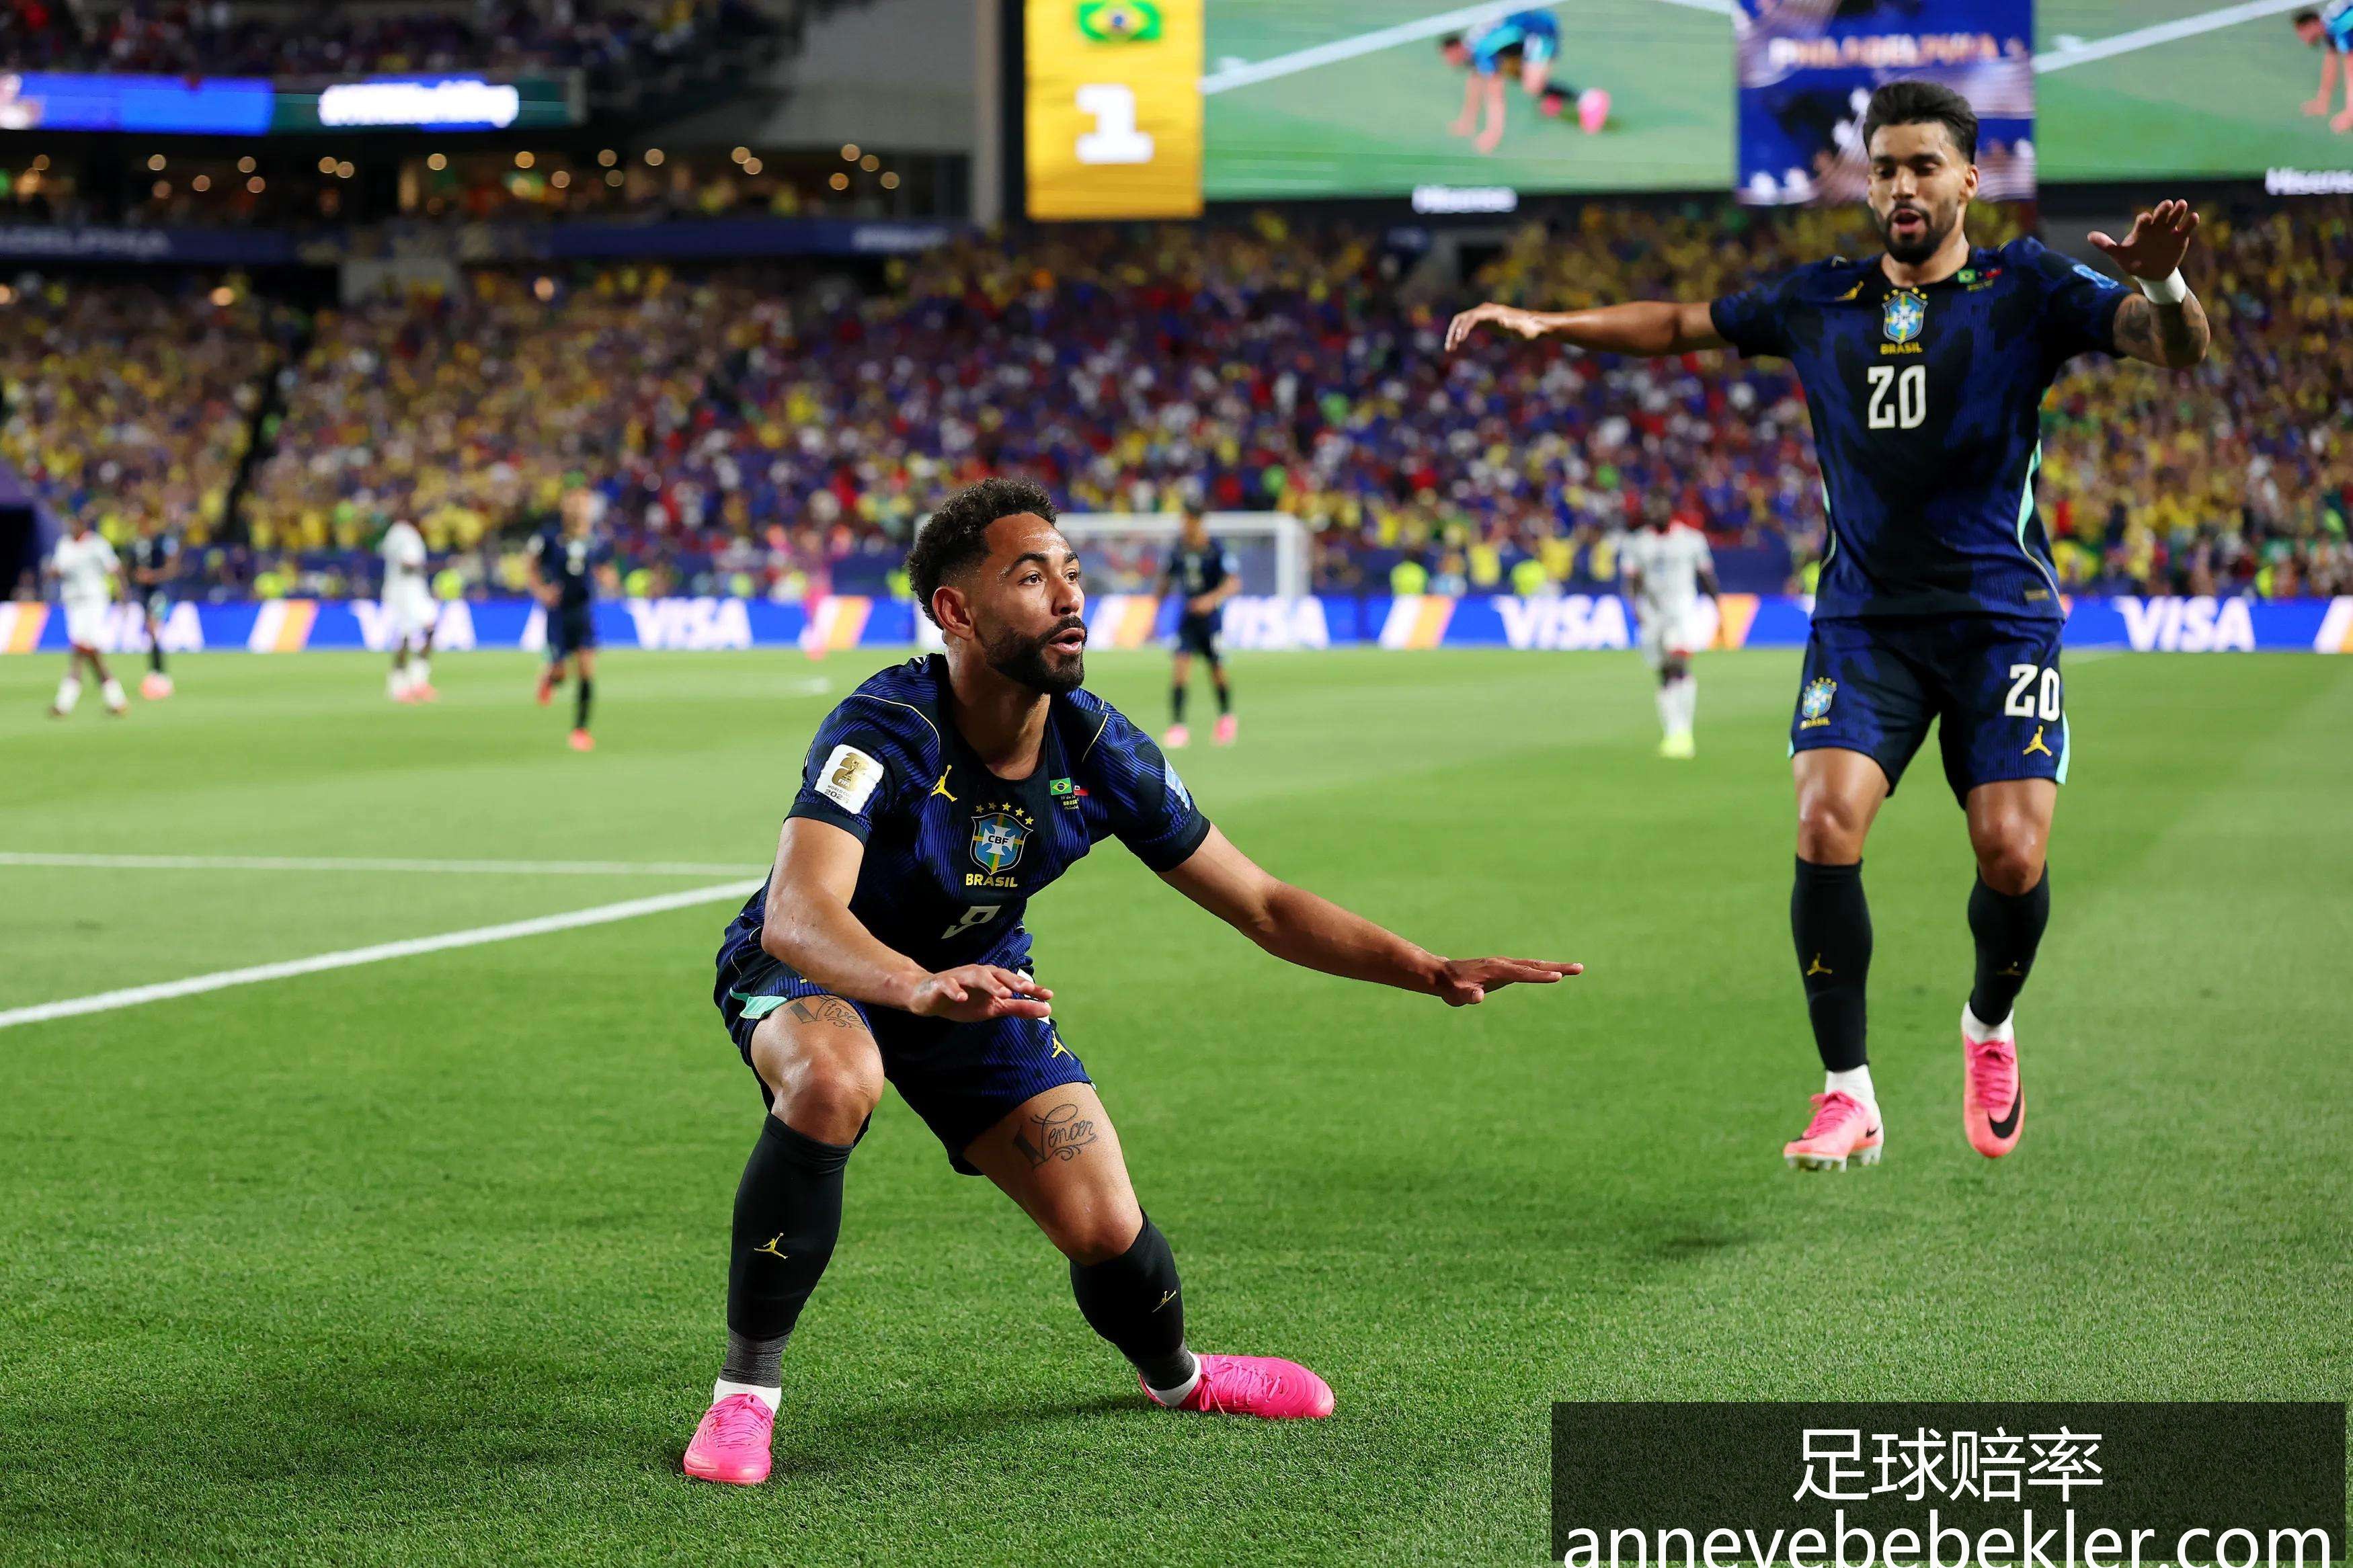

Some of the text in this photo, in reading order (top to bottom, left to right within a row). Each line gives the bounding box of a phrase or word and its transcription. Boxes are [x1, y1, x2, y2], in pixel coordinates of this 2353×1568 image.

[1075, 83, 1154, 163] 1
[1880, 341, 1923, 355] BRASIL
[1868, 364, 1926, 429] 20
[349, 599, 477, 651] VA
[624, 596, 754, 651] VISA
[1491, 595, 1630, 650] VISA
[2113, 595, 2256, 652] VISA
[2004, 663, 2060, 721] 20
[838, 778, 850, 788] FIFA
[988, 835, 1009, 845] CBF
[965, 873, 1018, 888] BRASIL
[941, 905, 1001, 939] 9
